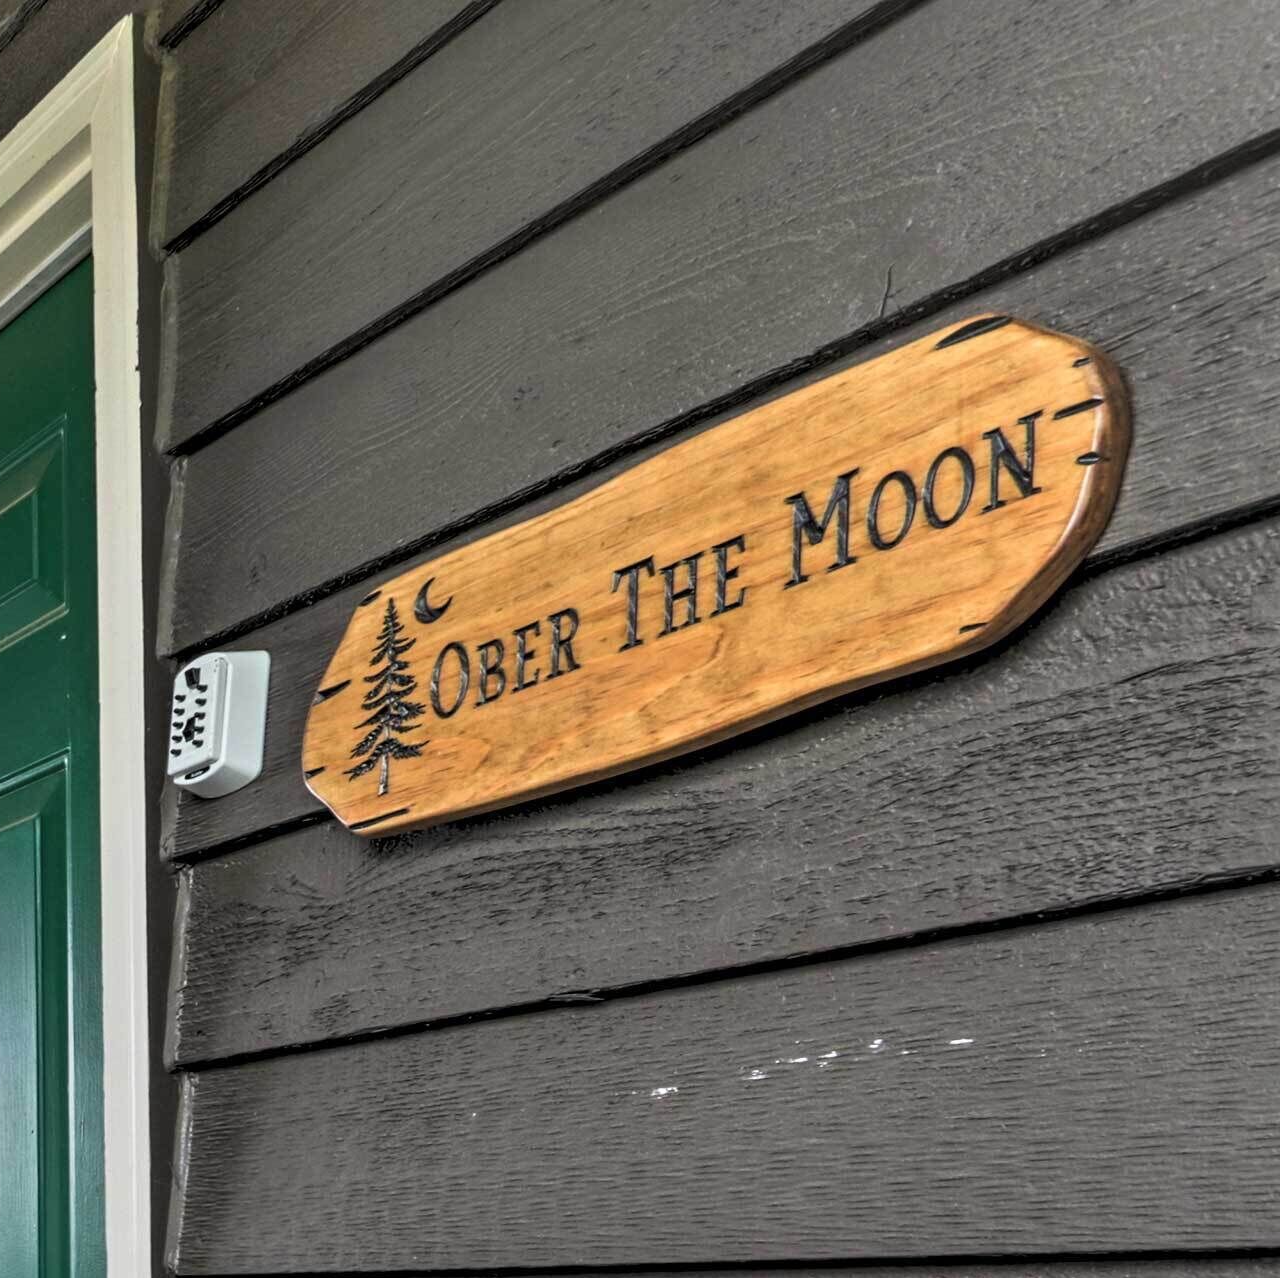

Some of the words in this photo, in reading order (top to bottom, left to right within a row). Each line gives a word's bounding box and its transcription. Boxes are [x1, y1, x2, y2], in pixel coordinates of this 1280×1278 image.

[430, 607, 581, 719] OBER
[611, 533, 747, 653] THE
[784, 410, 1042, 590] MOON
